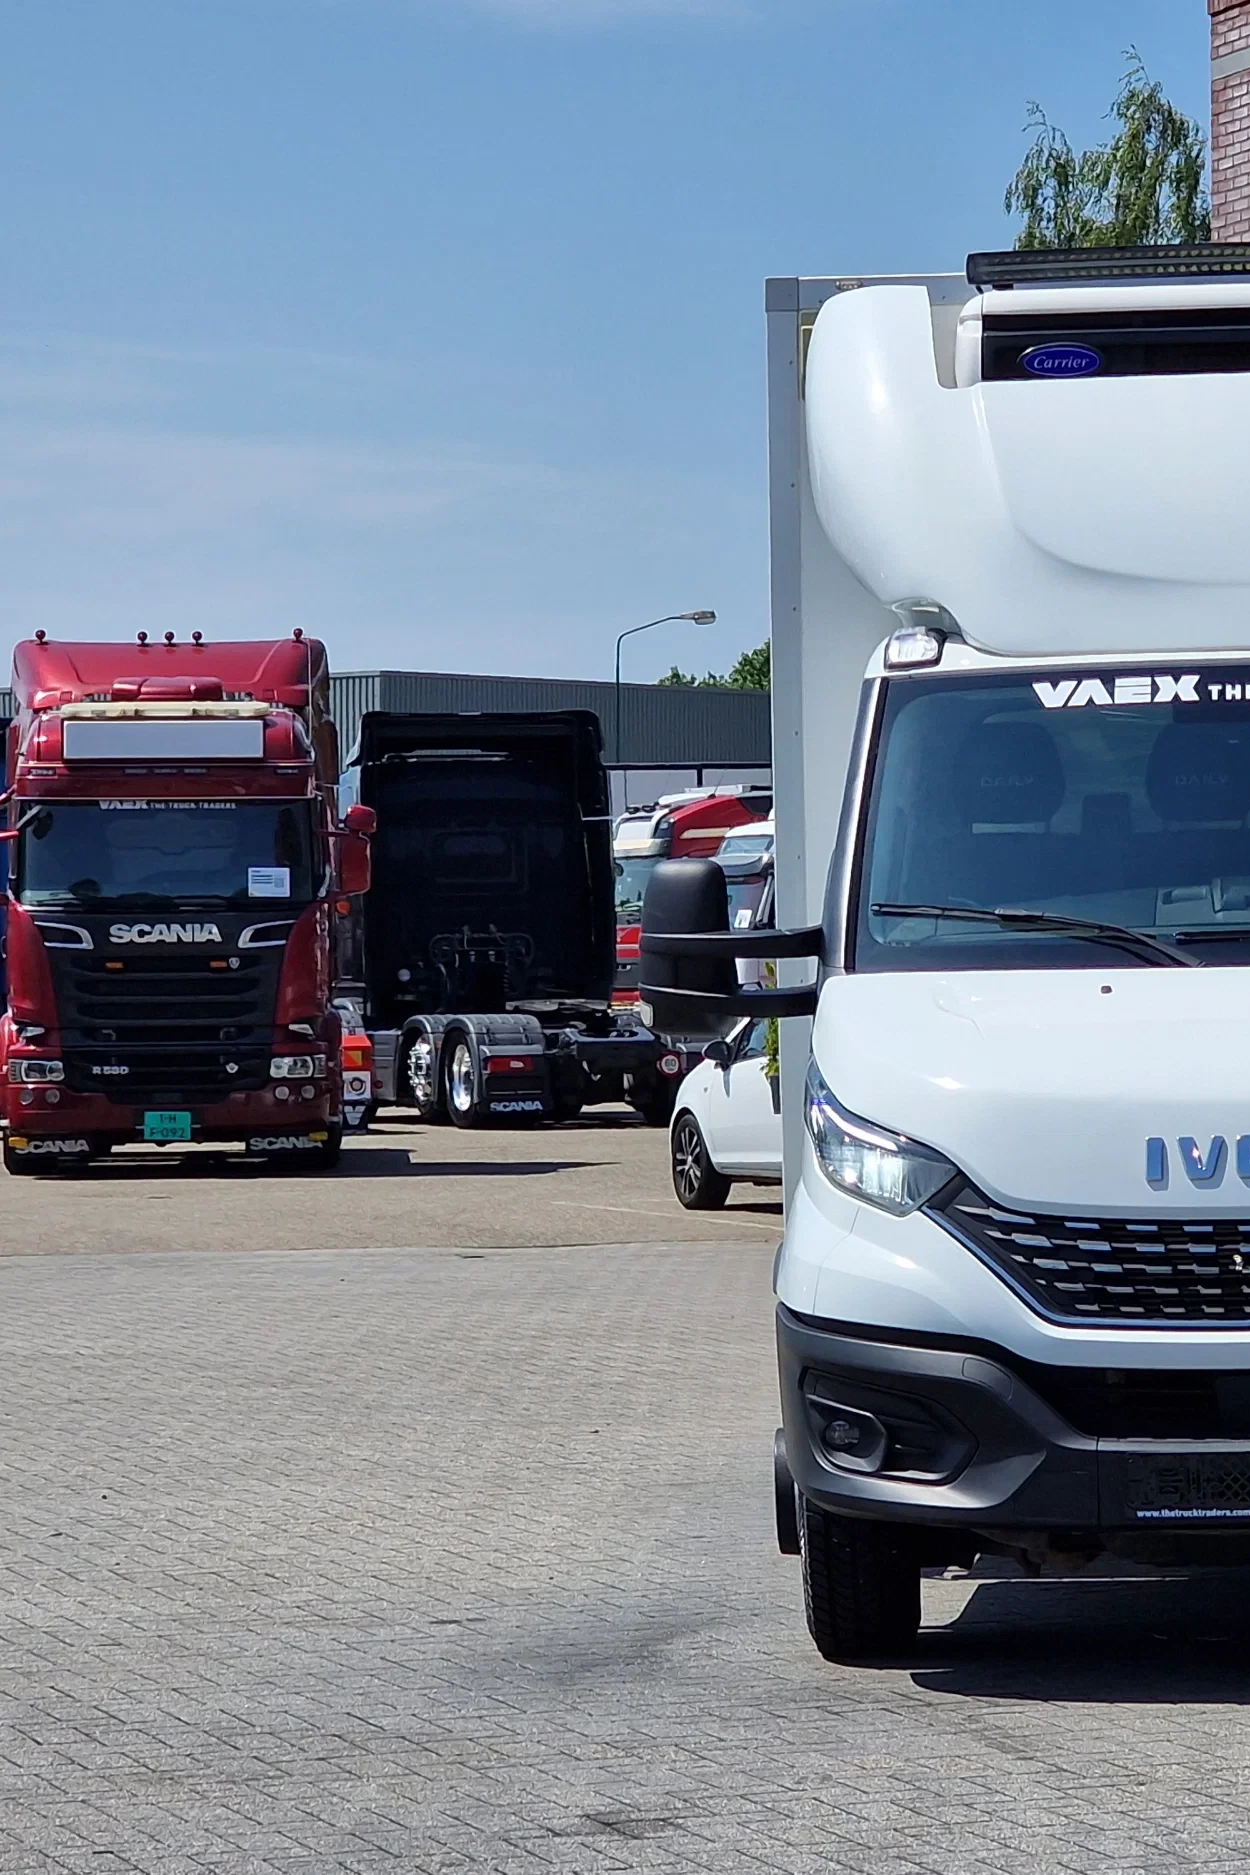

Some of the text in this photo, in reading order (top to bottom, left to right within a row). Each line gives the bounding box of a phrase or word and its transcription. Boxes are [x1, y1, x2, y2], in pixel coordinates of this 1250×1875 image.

[1033, 355, 1090, 369] Carrier
[1032, 675, 1201, 708] VAEX
[109, 923, 222, 943] SCANIA
[490, 1101, 543, 1112] SCANIA
